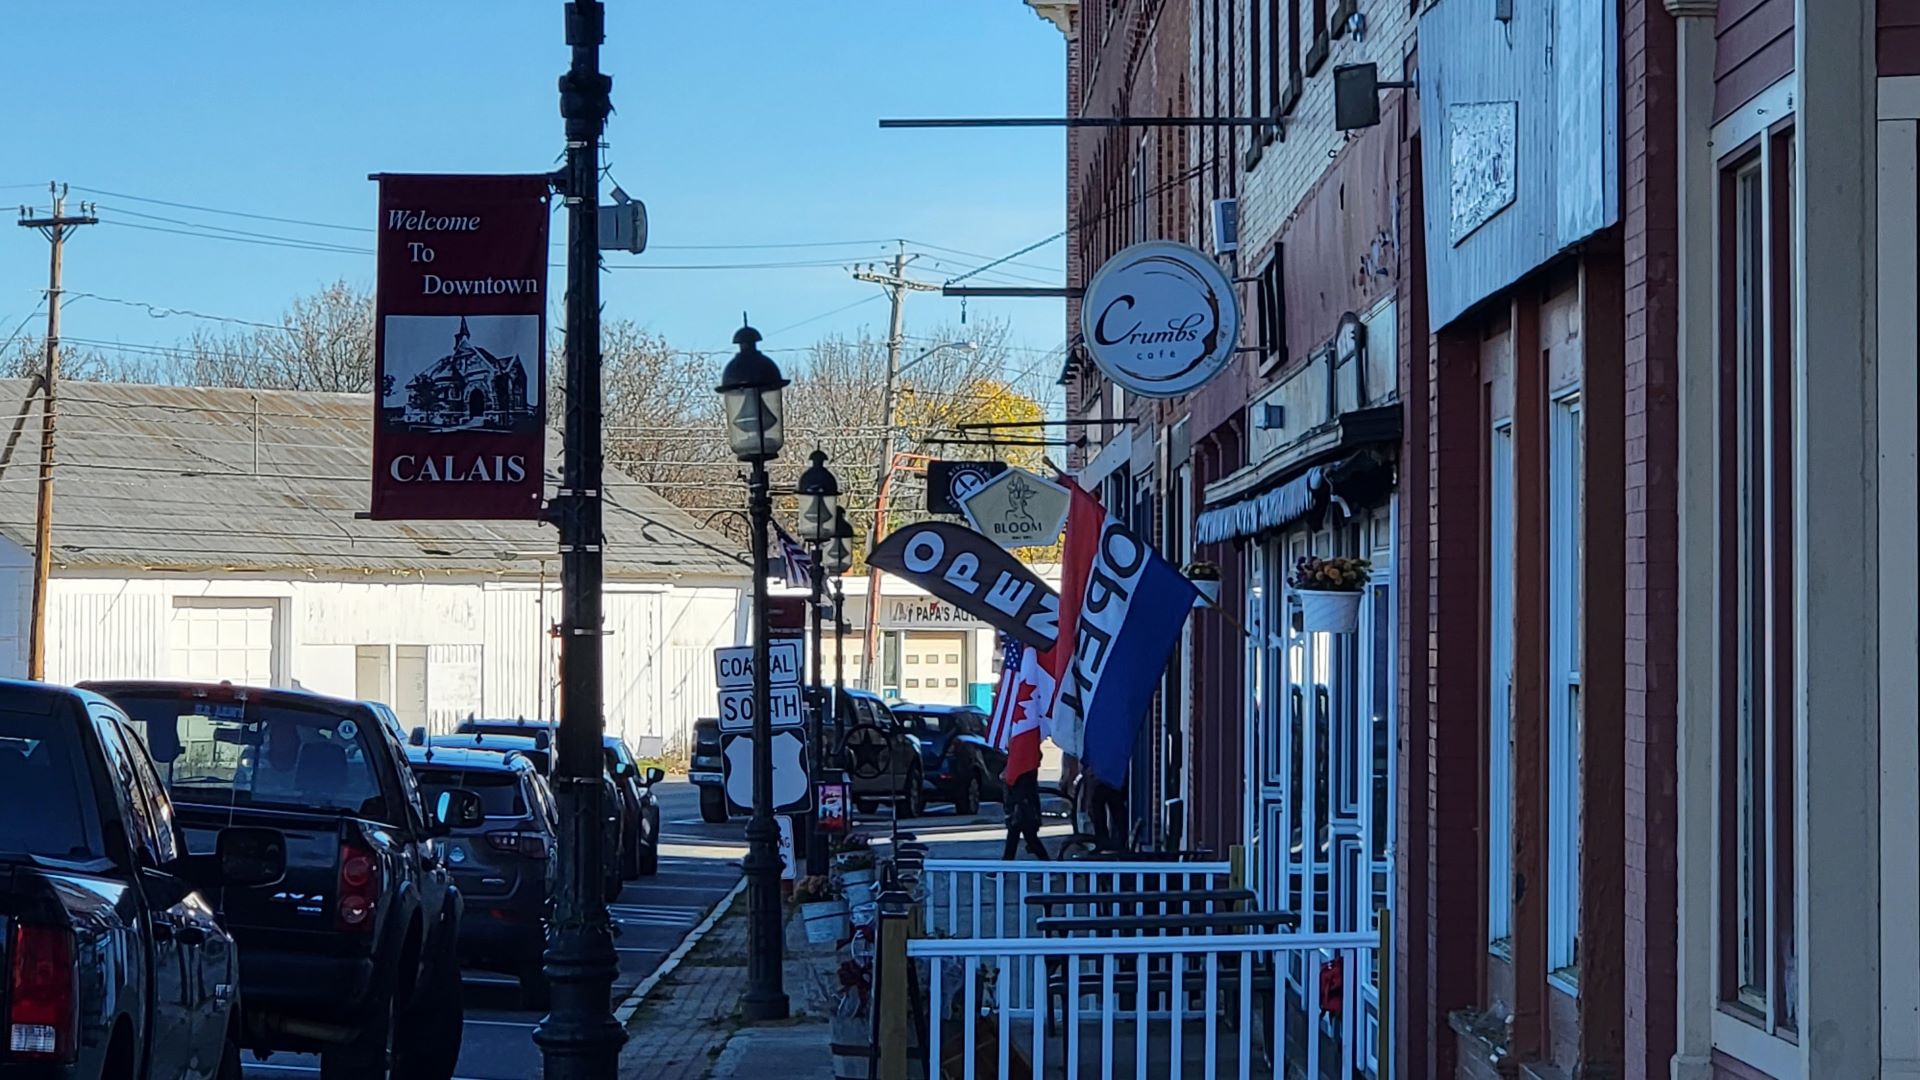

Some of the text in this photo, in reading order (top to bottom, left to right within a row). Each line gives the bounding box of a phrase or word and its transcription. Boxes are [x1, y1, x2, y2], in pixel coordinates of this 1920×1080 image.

[387, 209, 481, 231] Welcome
[408, 242, 435, 263] To
[422, 275, 538, 295] Downtown
[1094, 294, 1205, 346] Crumbs
[390, 455, 526, 482] CALAIS
[994, 521, 1042, 534] BLOOM
[904, 530, 1060, 640] OPEN
[916, 606, 950, 621] PAPA'S
[720, 654, 793, 677] COAAL
[724, 694, 797, 721] SOTH
